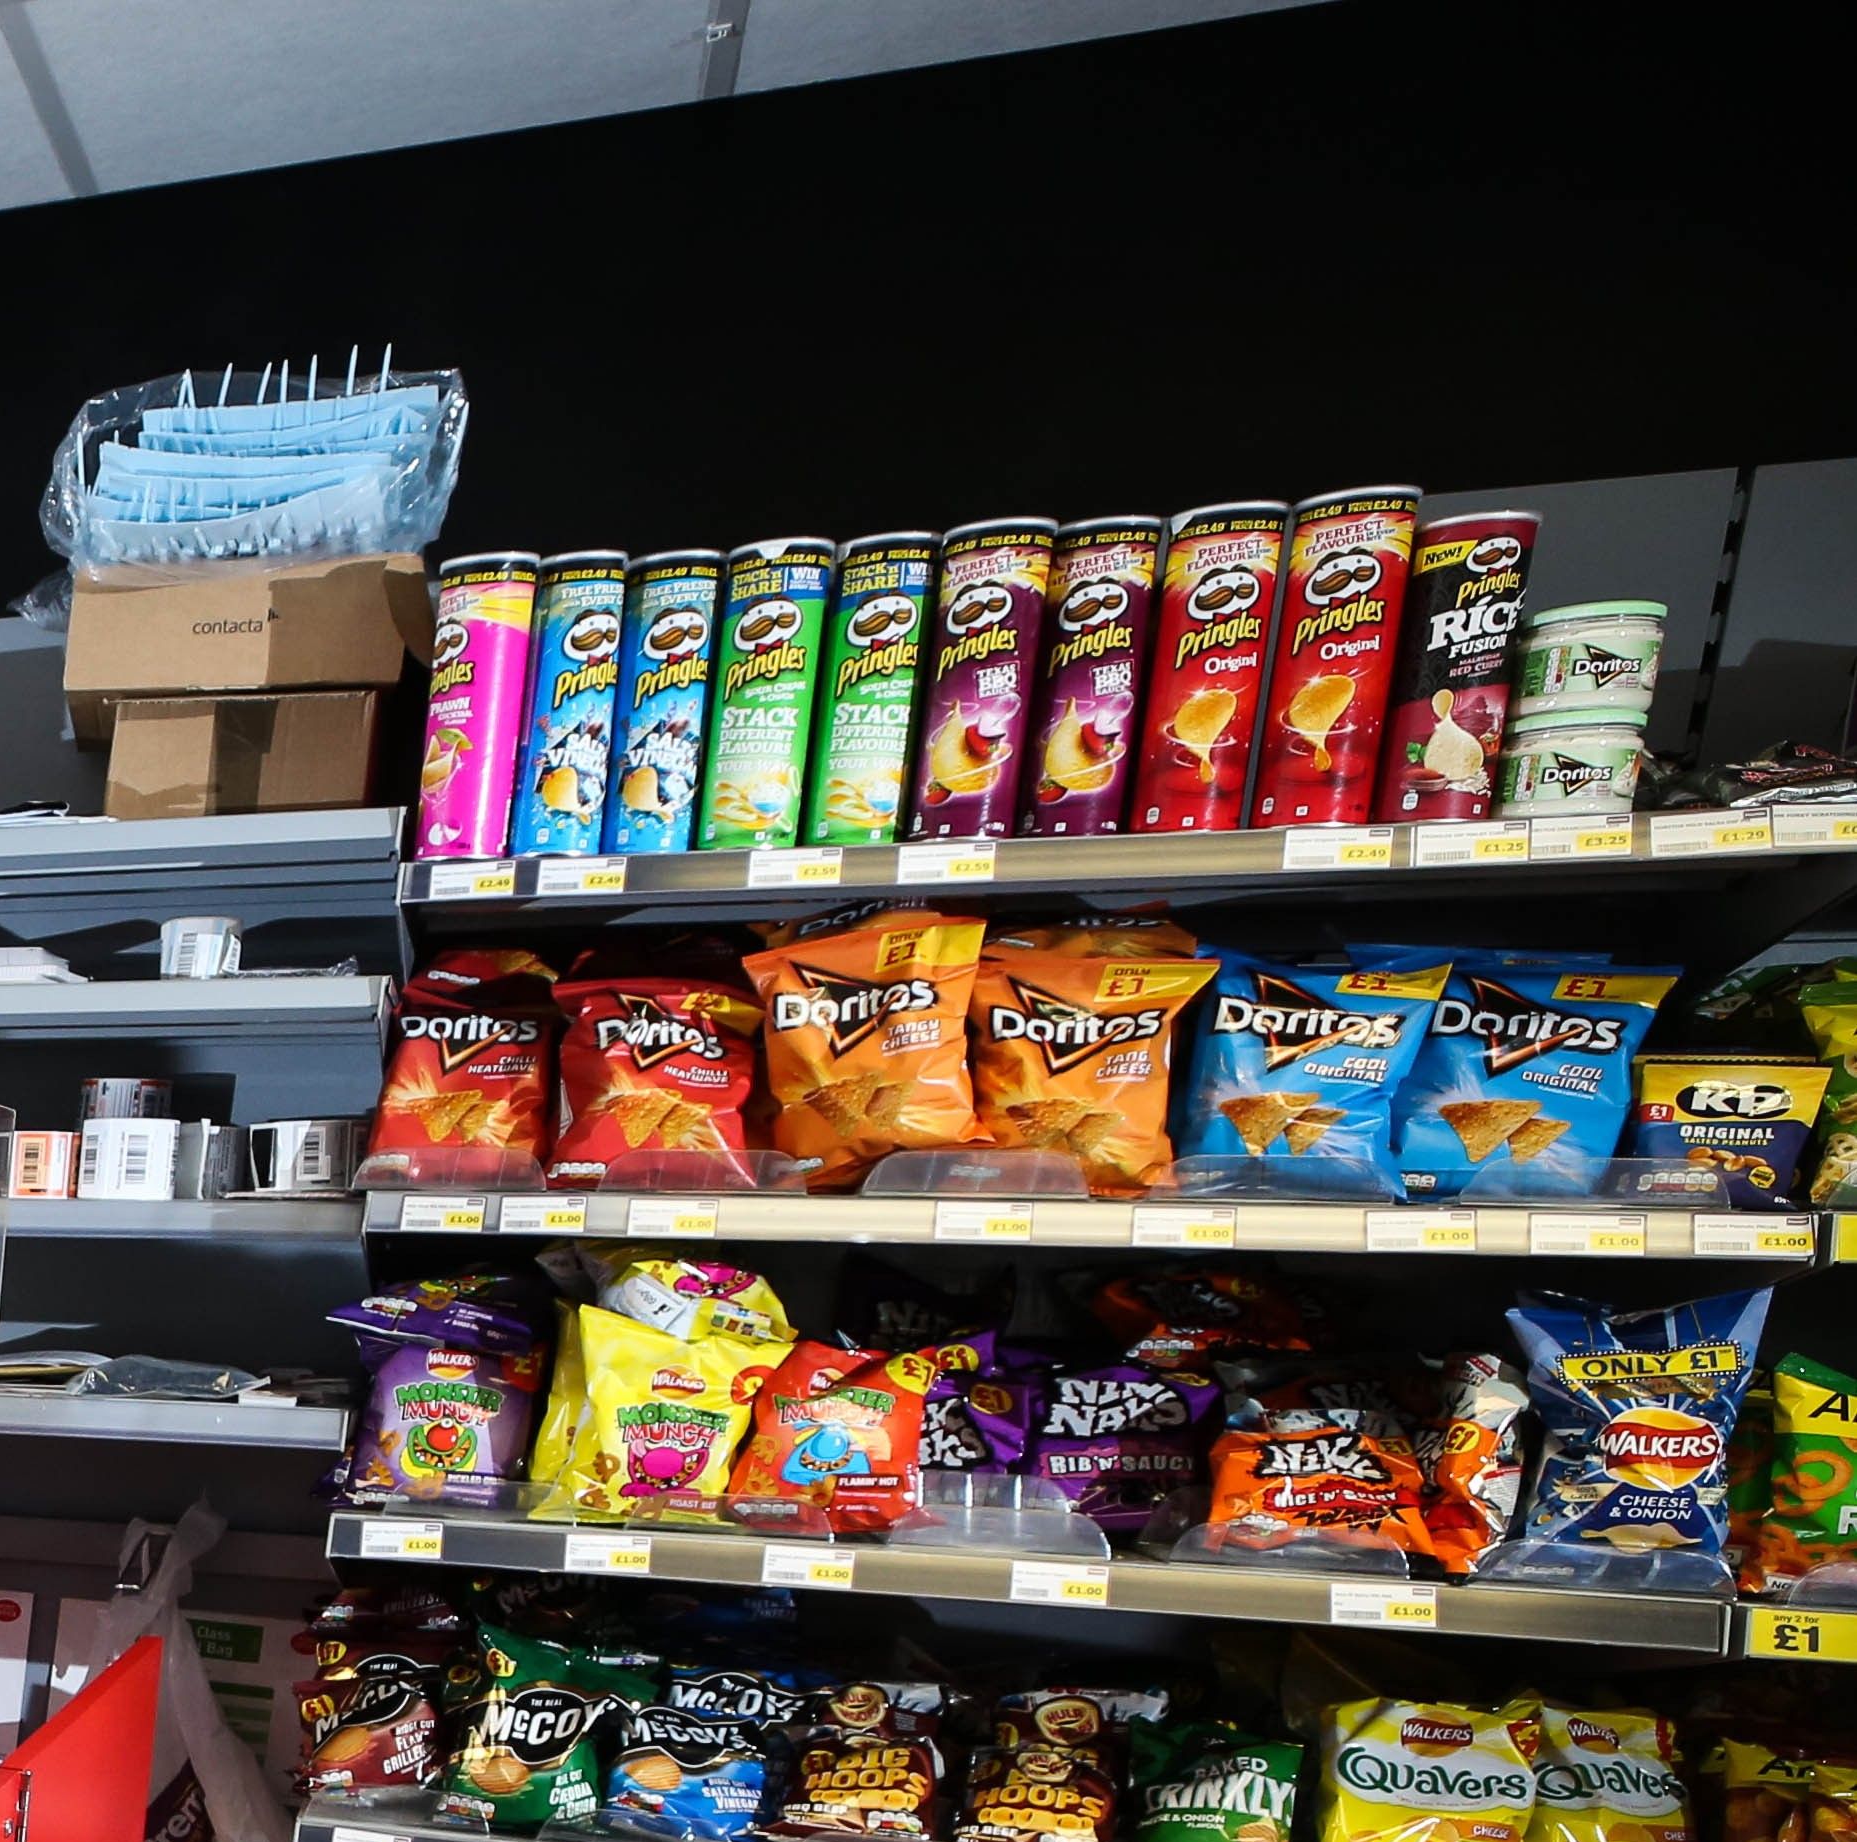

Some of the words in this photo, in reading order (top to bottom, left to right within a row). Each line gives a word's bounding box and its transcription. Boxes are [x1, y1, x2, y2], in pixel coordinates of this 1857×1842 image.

[192, 617, 263, 633] contacta
[1176, 614, 1261, 666] Pringles
[1450, 634, 1507, 659] FUSION
[936, 628, 1017, 678] Pringles
[1204, 653, 1257, 674] Original
[1721, 829, 1764, 842] £1.29
[775, 979, 935, 1031] Doritos
[889, 1019, 939, 1038] TANGY
[1214, 997, 1401, 1047] Doritos
[882, 1030, 939, 1049] CHEESE
[1687, 1082, 1791, 1117] KP
[1680, 1125, 1774, 1141] ORIGINAL
[1763, 1236, 1806, 1248] £1.00
[1582, 1353, 1673, 1378] ONLY
[1690, 1349, 1720, 1371] £1
[1600, 1431, 1721, 1461] WALKERS
[1610, 1505, 1624, 1518] &
[1629, 1503, 1693, 1521] ONION
[1618, 1494, 1691, 1511] CHEESE
[1393, 1606, 1432, 1618] £1.00
[1774, 1614, 1791, 1626] any
[1794, 1615, 1801, 1623] 2
[1804, 1614, 1820, 1623] for
[1774, 1625, 1821, 1653] £1
